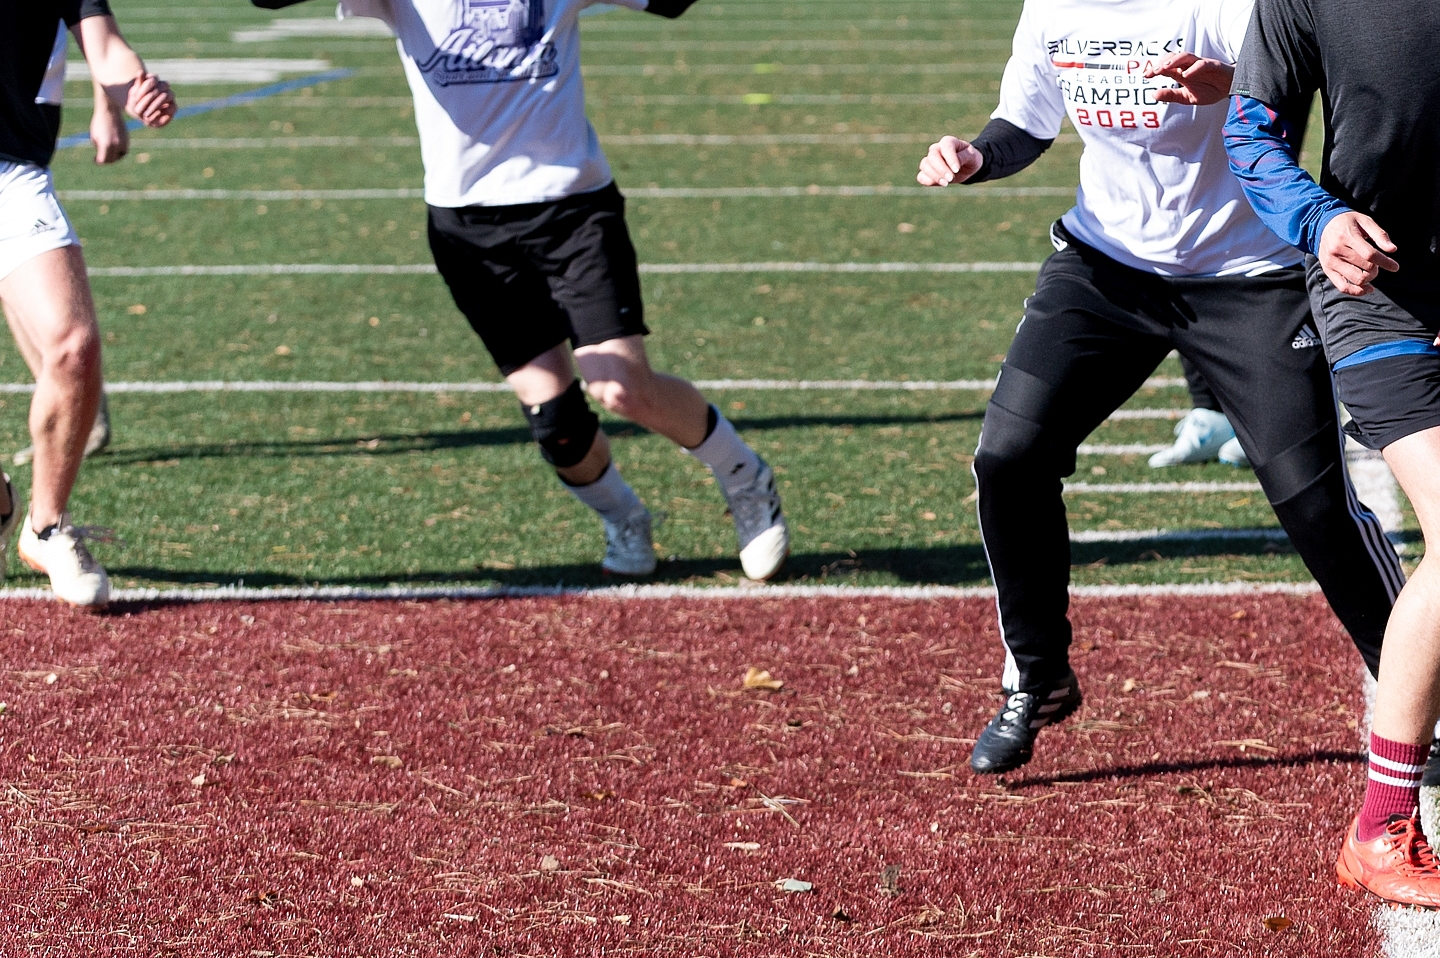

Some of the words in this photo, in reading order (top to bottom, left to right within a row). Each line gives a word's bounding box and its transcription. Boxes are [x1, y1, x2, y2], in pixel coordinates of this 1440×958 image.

[1127, 60, 1154, 74] PA
[1076, 73, 1150, 84] LEAGUE
[1077, 108, 1160, 128] 2023
